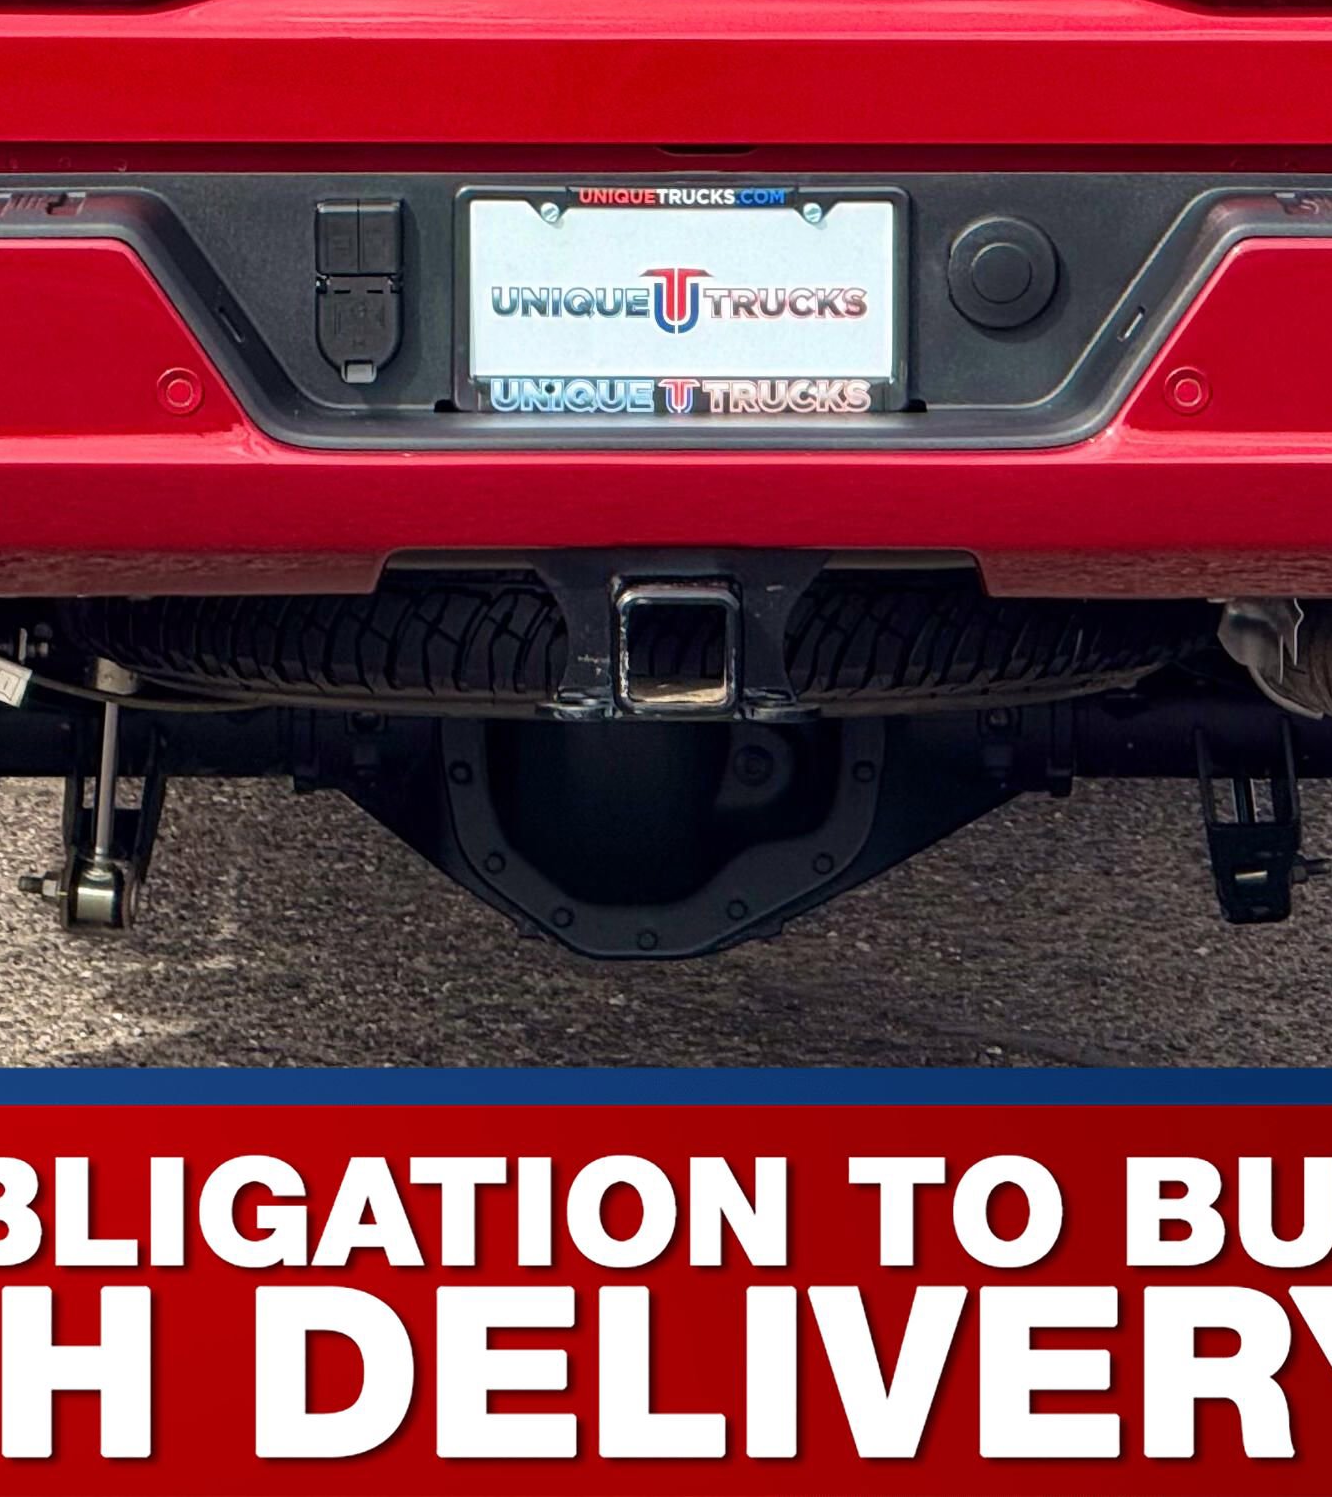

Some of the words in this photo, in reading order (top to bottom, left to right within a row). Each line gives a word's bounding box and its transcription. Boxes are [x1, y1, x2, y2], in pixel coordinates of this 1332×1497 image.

[578, 187, 786, 206] UNIQUETRUCKS.COM
[491, 286, 651, 320] UNIQUE
[703, 287, 869, 320] TRUCKS
[490, 378, 655, 414] UNIQUE
[702, 378, 872, 414] TRUCKS
